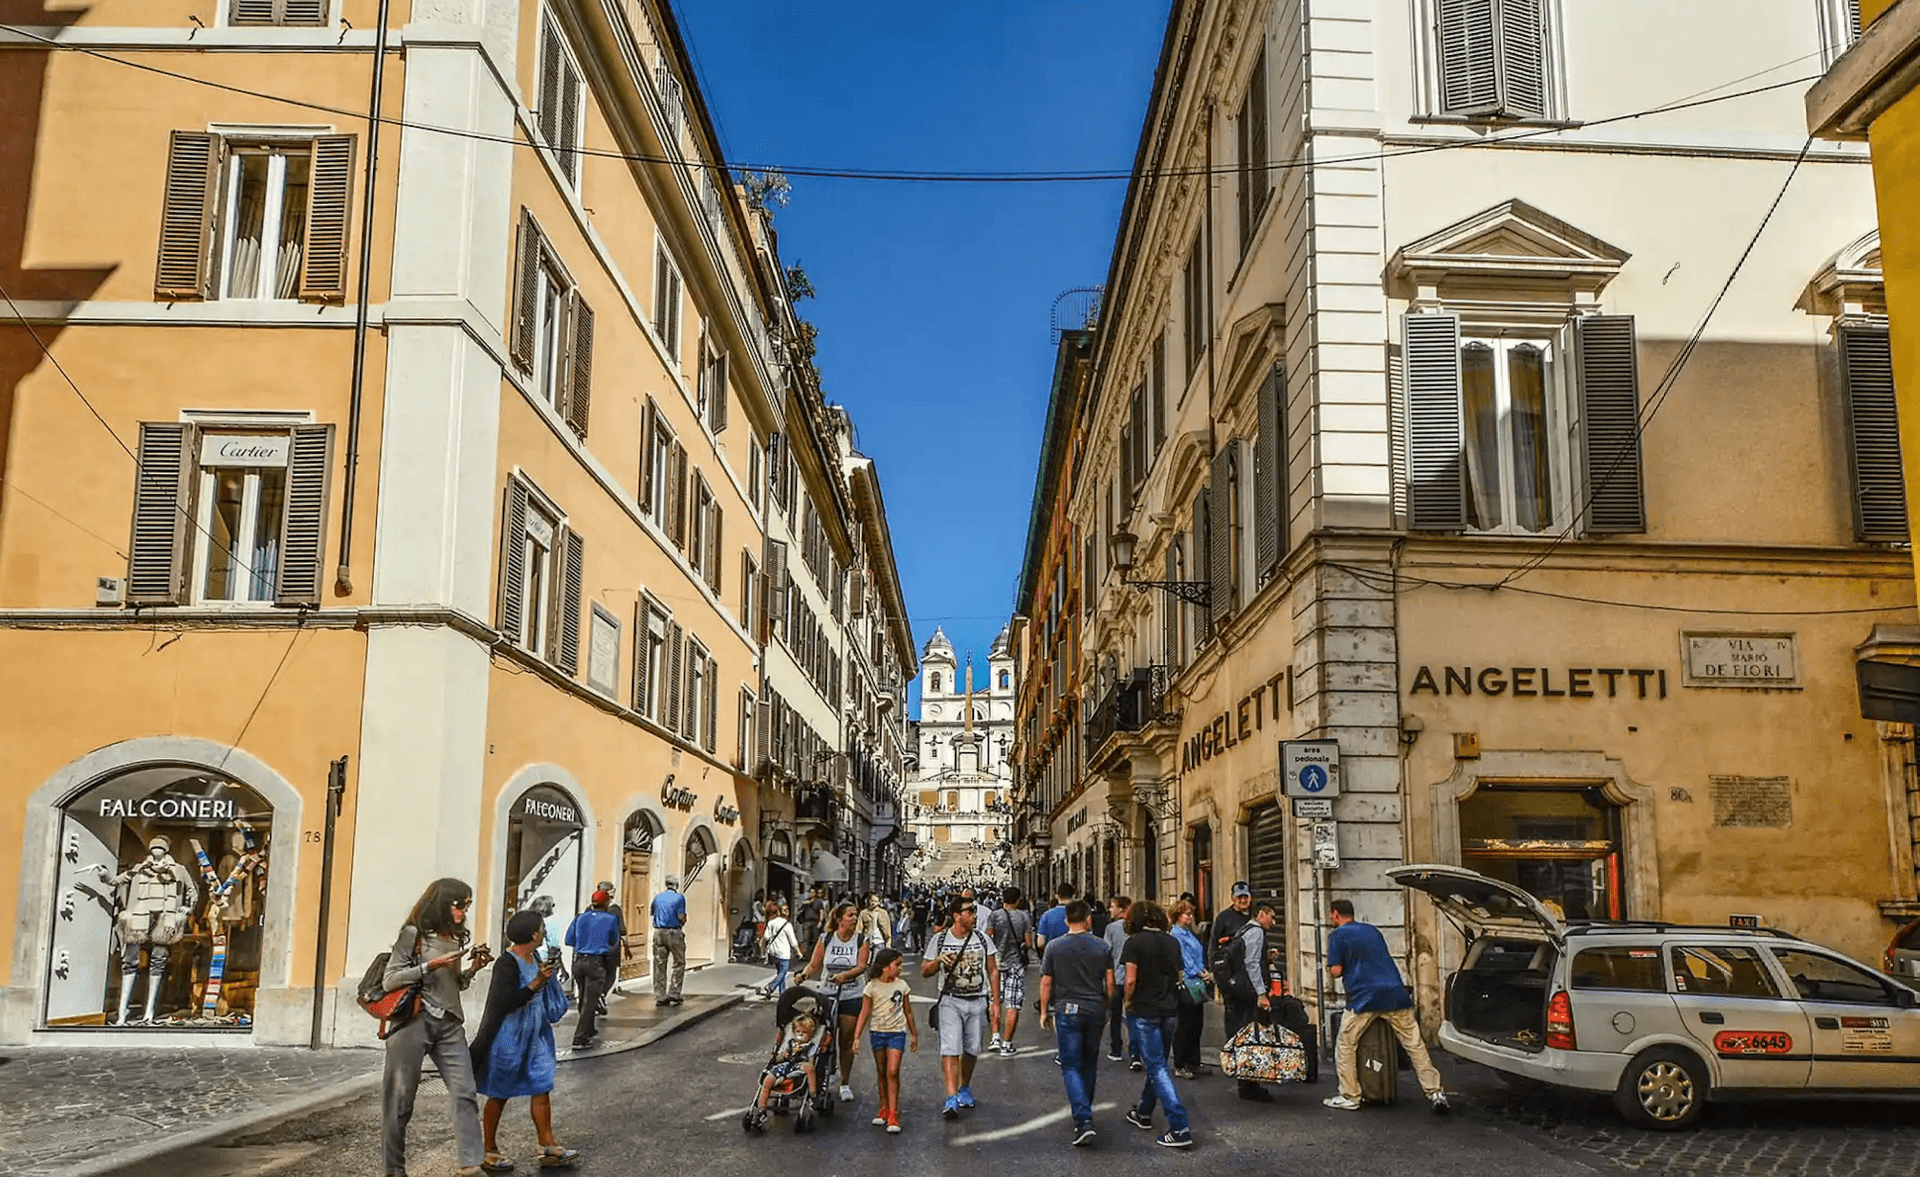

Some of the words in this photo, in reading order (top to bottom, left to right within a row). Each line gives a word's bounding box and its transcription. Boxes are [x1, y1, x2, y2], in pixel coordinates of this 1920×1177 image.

[220, 441, 278, 458] Cartier
[1729, 640, 1753, 651] VIA
[1732, 653, 1767, 662] MARIO
[1733, 664, 1780, 676] FIORI
[1409, 666, 1667, 699] ANGELETTI
[1181, 664, 1294, 776] ANGELETTI
[661, 774, 697, 814] Cartier
[99, 799, 234, 819] FALCONERI
[525, 798, 575, 822] FALCONERI
[305, 831, 321, 843] 78
[1732, 917, 1755, 927] TAXI
[831, 945, 854, 956] KELLY
[1753, 1036, 1786, 1049] 6645
